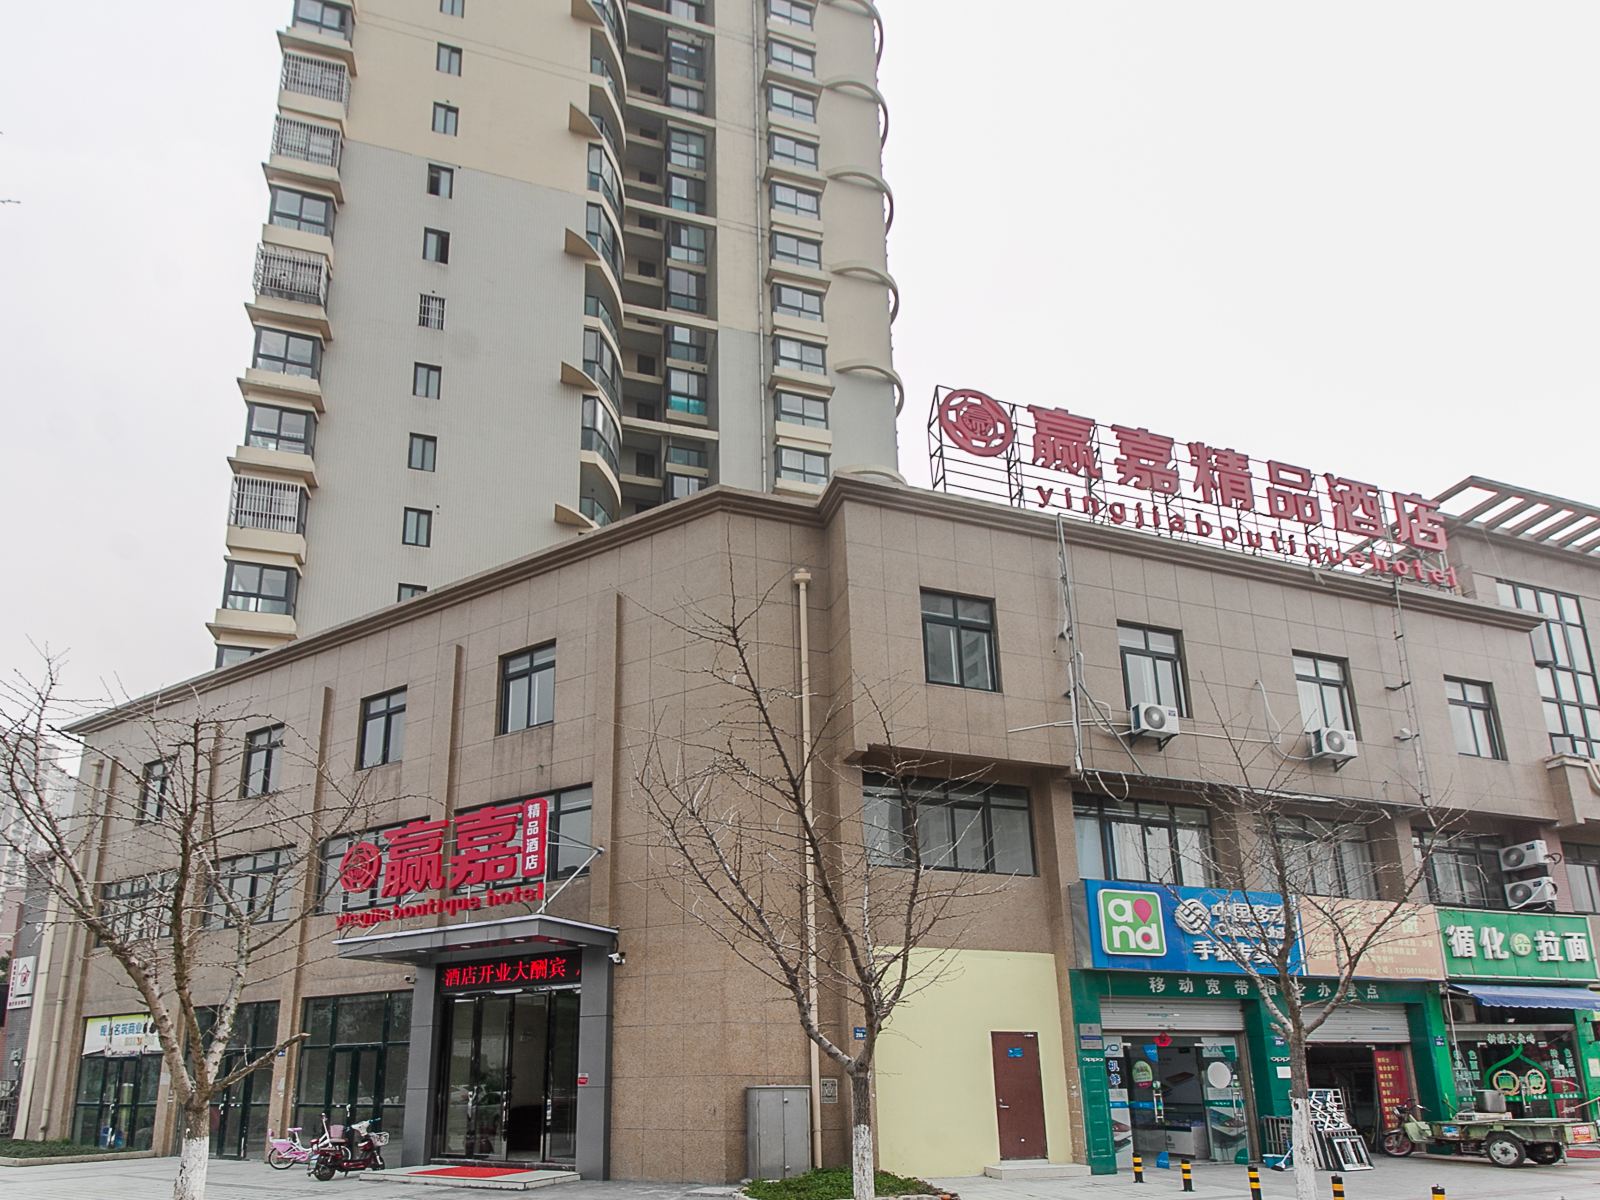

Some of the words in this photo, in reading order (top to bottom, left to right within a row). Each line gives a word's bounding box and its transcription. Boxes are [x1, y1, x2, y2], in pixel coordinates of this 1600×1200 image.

[1028, 404, 1448, 551] 赢嘉精品酒店
[381, 805, 524, 898] 赢嘉
[525, 803, 541, 870] 精品酒店
[487, 882, 544, 907] hotel
[1445, 925, 1510, 960] 循化
[1534, 930, 1590, 962] 拉面
[444, 957, 567, 987] 酒店开业大酬宾
